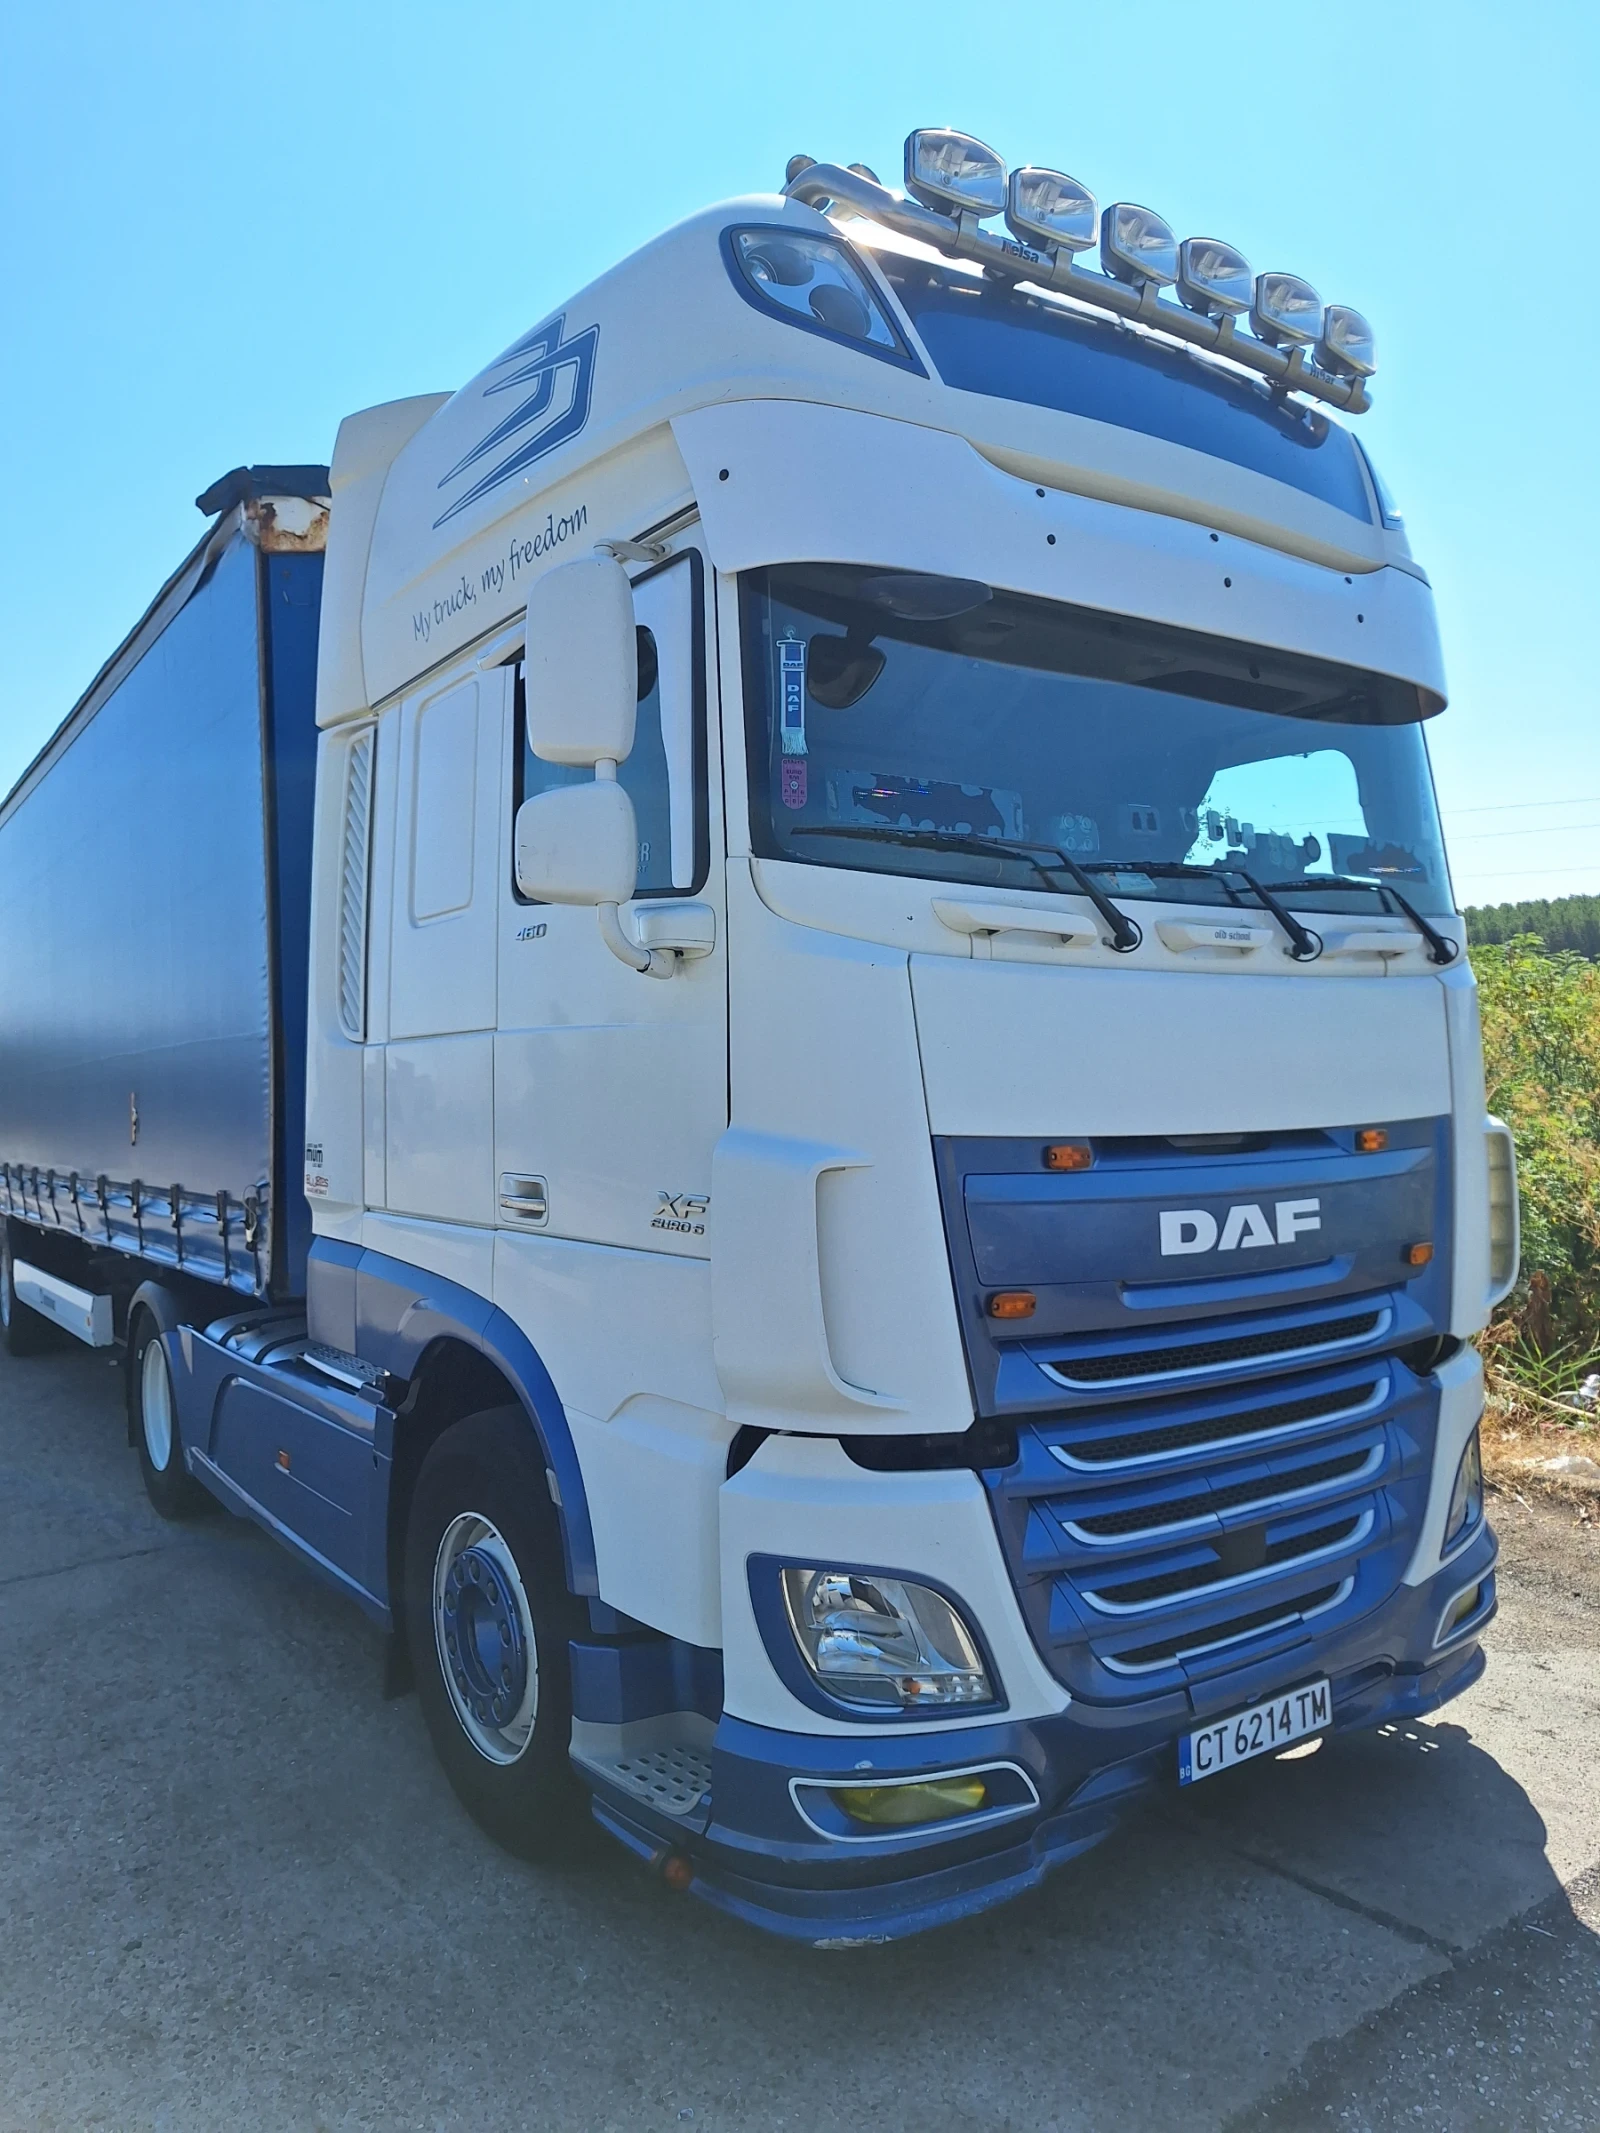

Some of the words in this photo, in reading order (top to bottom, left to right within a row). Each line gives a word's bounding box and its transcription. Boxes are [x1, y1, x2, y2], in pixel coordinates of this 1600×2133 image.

[413, 611, 431, 642] My
[433, 575, 477, 625] truck,
[481, 558, 505, 593] my
[509, 504, 588, 581] freedom
[787, 684, 800, 712] DAF
[1228, 931, 1251, 941] school
[653, 1190, 711, 1219] XF
[650, 1217, 691, 1234] EURO
[1158, 1197, 1322, 1256] DAF
[1179, 1764, 1191, 1780] BG
